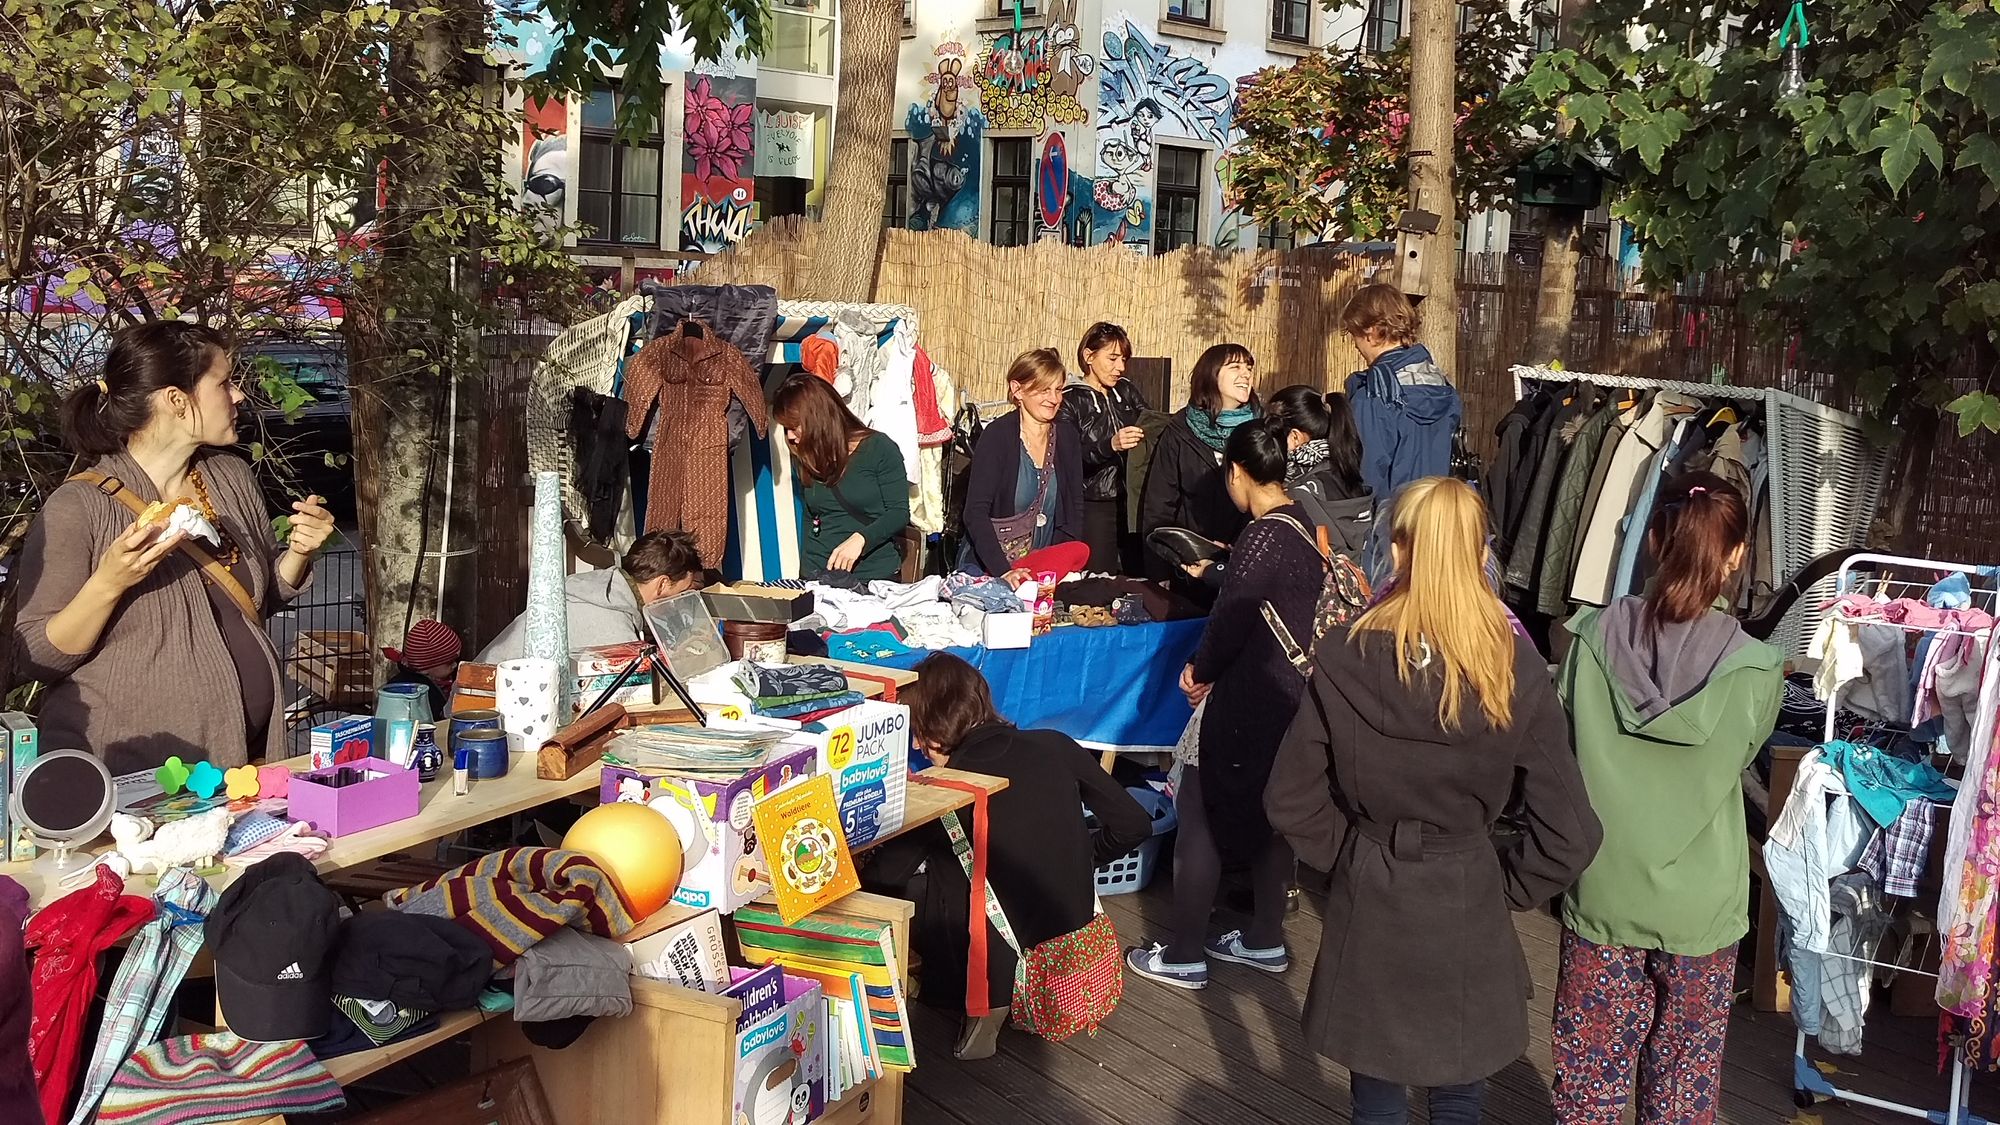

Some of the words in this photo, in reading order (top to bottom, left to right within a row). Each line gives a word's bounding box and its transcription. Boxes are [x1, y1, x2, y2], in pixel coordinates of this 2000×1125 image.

[857, 713, 905, 744] JUMBO
[832, 732, 850, 756] 72
[856, 738, 886, 760] PACK
[841, 764, 887, 788] babylove
[780, 801, 812, 819] Waldtiere
[845, 809, 856, 833] 5
[686, 932, 699, 954] VON
[673, 940, 691, 971] NACH
[707, 926, 725, 985] GROSSER
[277, 972, 304, 980] adidas
[667, 950, 691, 989] JERUSAL
[743, 977, 778, 1011] ildren's
[743, 1021, 785, 1052] babylove
